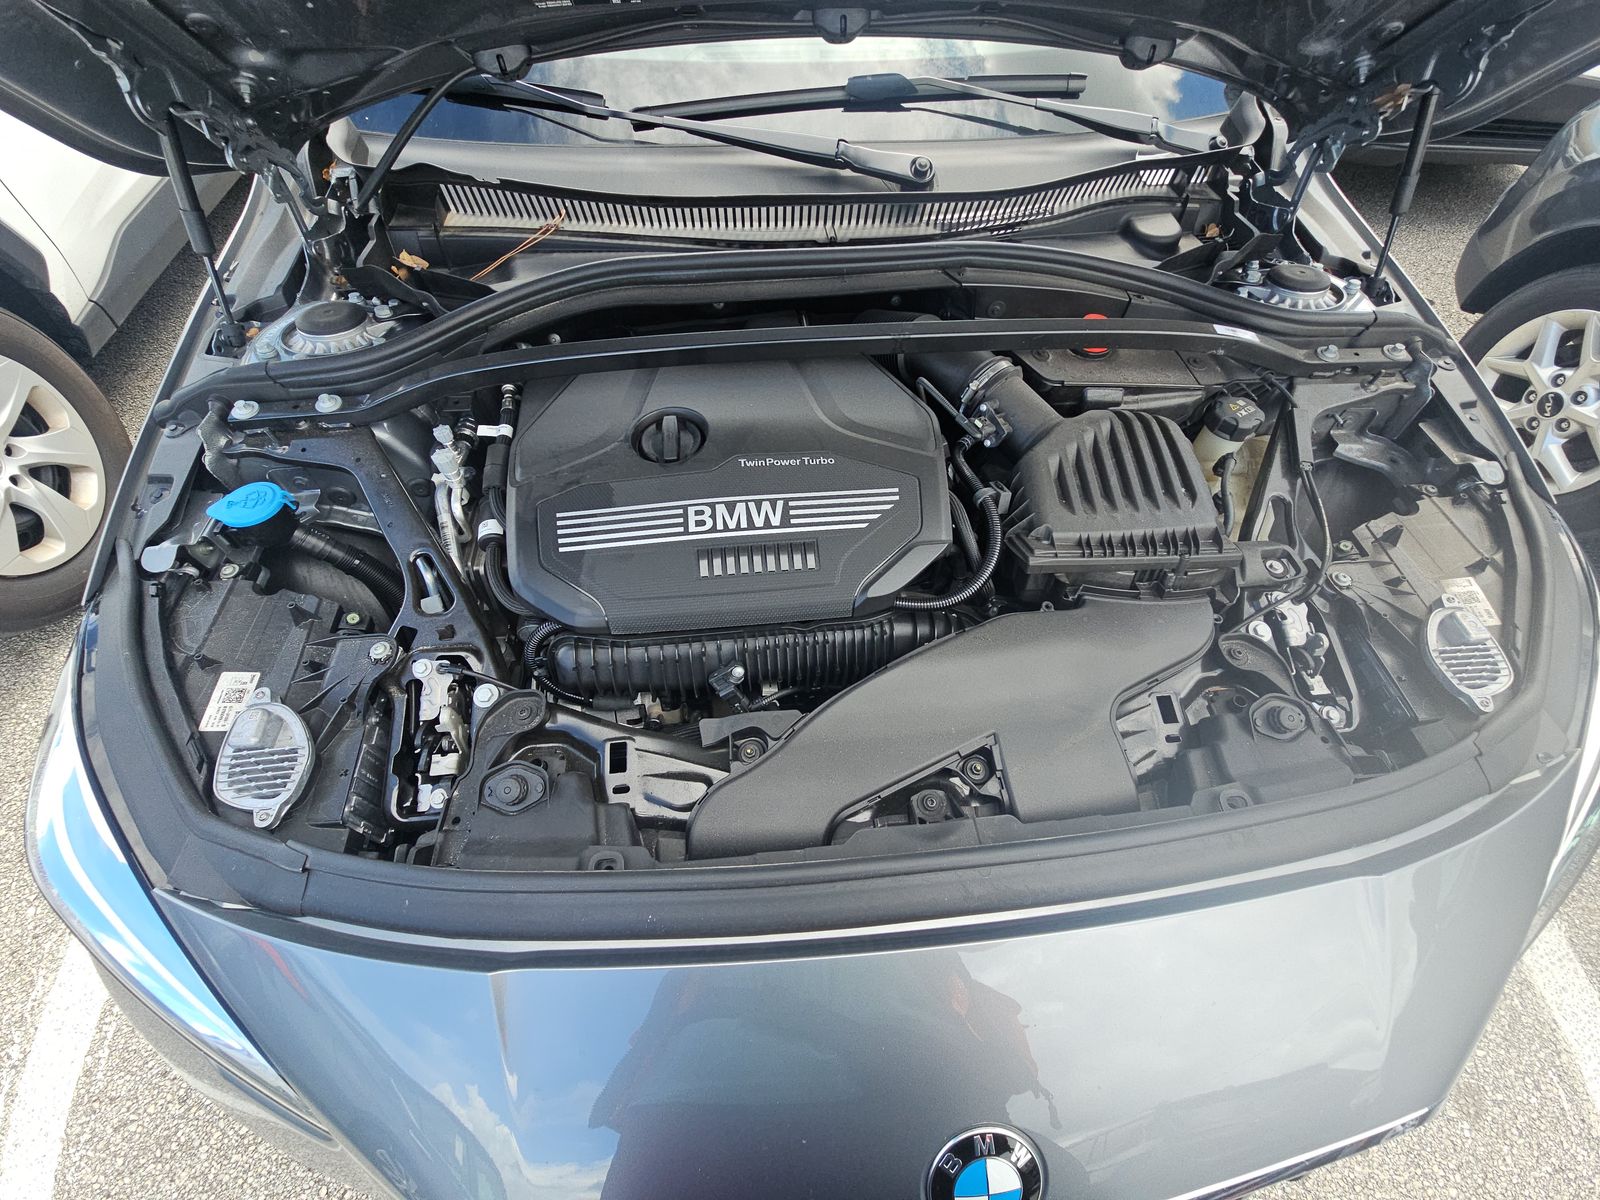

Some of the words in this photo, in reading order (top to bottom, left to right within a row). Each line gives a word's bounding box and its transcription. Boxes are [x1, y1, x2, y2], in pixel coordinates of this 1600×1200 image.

[738, 457, 801, 468] TwinPower
[802, 456, 835, 466] Turbo
[687, 500, 784, 533] BMW
[938, 1133, 1032, 1178] BMW
